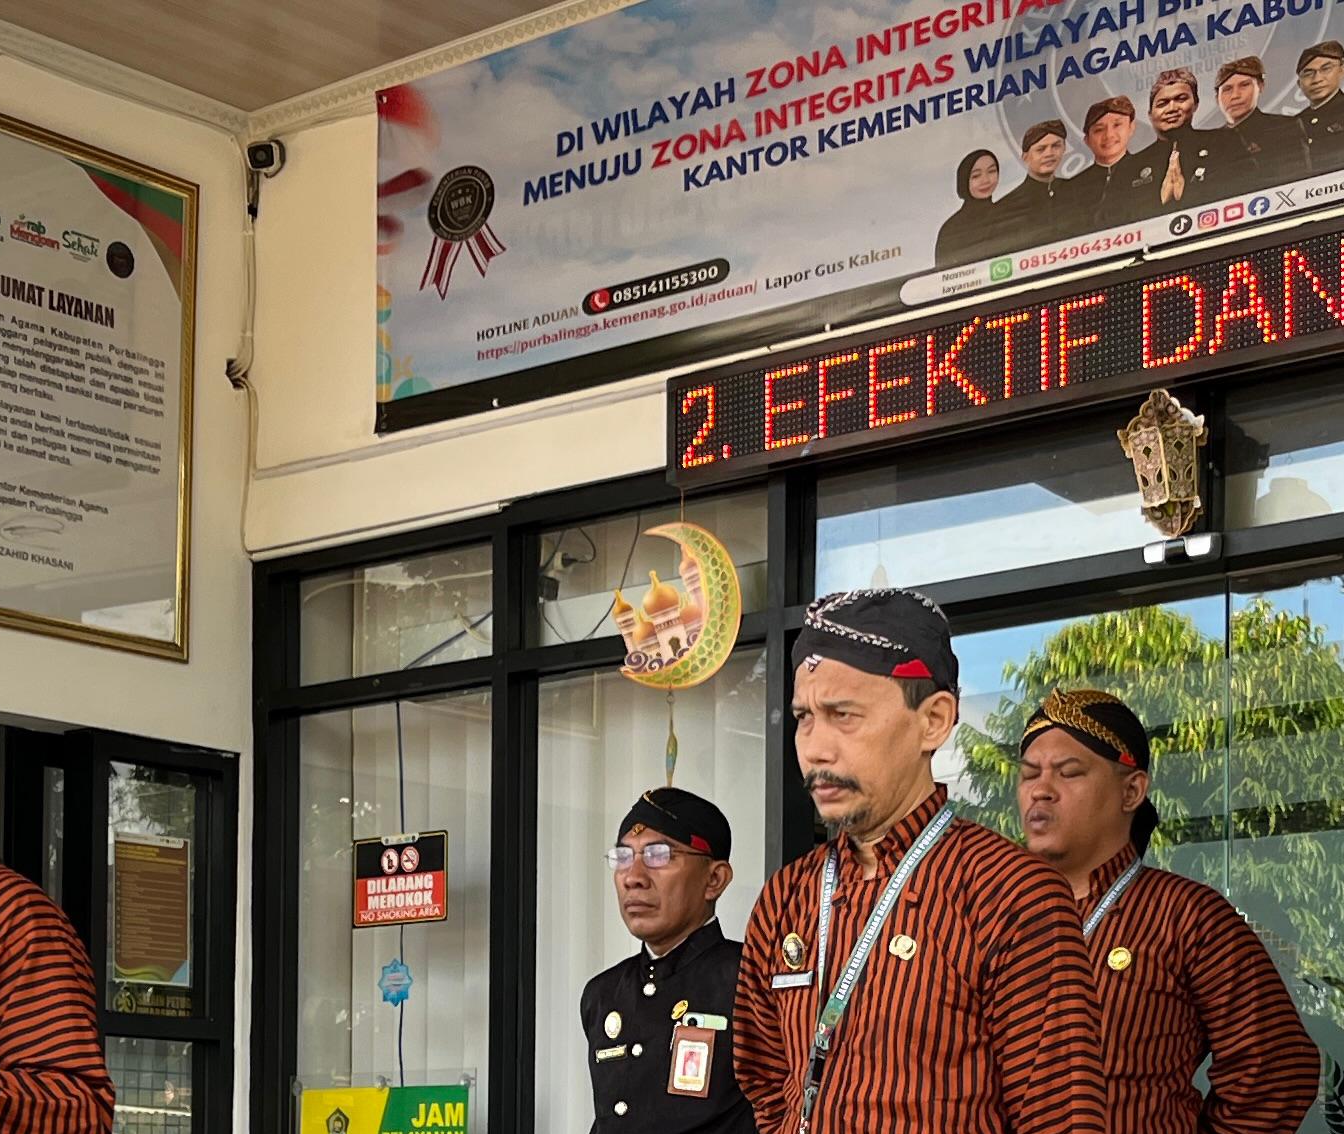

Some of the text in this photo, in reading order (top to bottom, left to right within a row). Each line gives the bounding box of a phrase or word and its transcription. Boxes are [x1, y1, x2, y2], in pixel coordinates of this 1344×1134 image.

[522, 0, 1145, 206] MENUJU ZONA INTEGRITAS WILAYAH
[556, 126, 585, 158] DI
[590, 76, 736, 146] WILAYAH
[744, 44, 849, 101] ZONA
[683, 134, 810, 192] KANTOR
[817, 66, 1047, 154] KEMENTERIAN
[1056, 20, 1197, 86] AGAMA
[1018, 229, 1143, 272] 081549643401
[941, 266, 977, 282] Nomor
[941, 275, 982, 295] layanan
[48, 289, 115, 329] LAYANAN
[476, 243, 902, 362] https://purbalingga.kemenag.go.id/aduan/ Lapor Gus Kakan
[476, 264, 719, 342] HOTLINE ADUAN 085141155300
[11, 315, 45, 333] Agama
[50, 327, 104, 350] Kabupaten
[679, 383, 733, 470] 2.
[762, 294, 1104, 452] EFEKTIF
[0, 546, 30, 562] ZAHID
[367, 873, 434, 895] DILARANG
[367, 890, 433, 911] MEROKOK
[359, 905, 441, 922] NO SMOKING AREA
[411, 1102, 464, 1128] JAM
